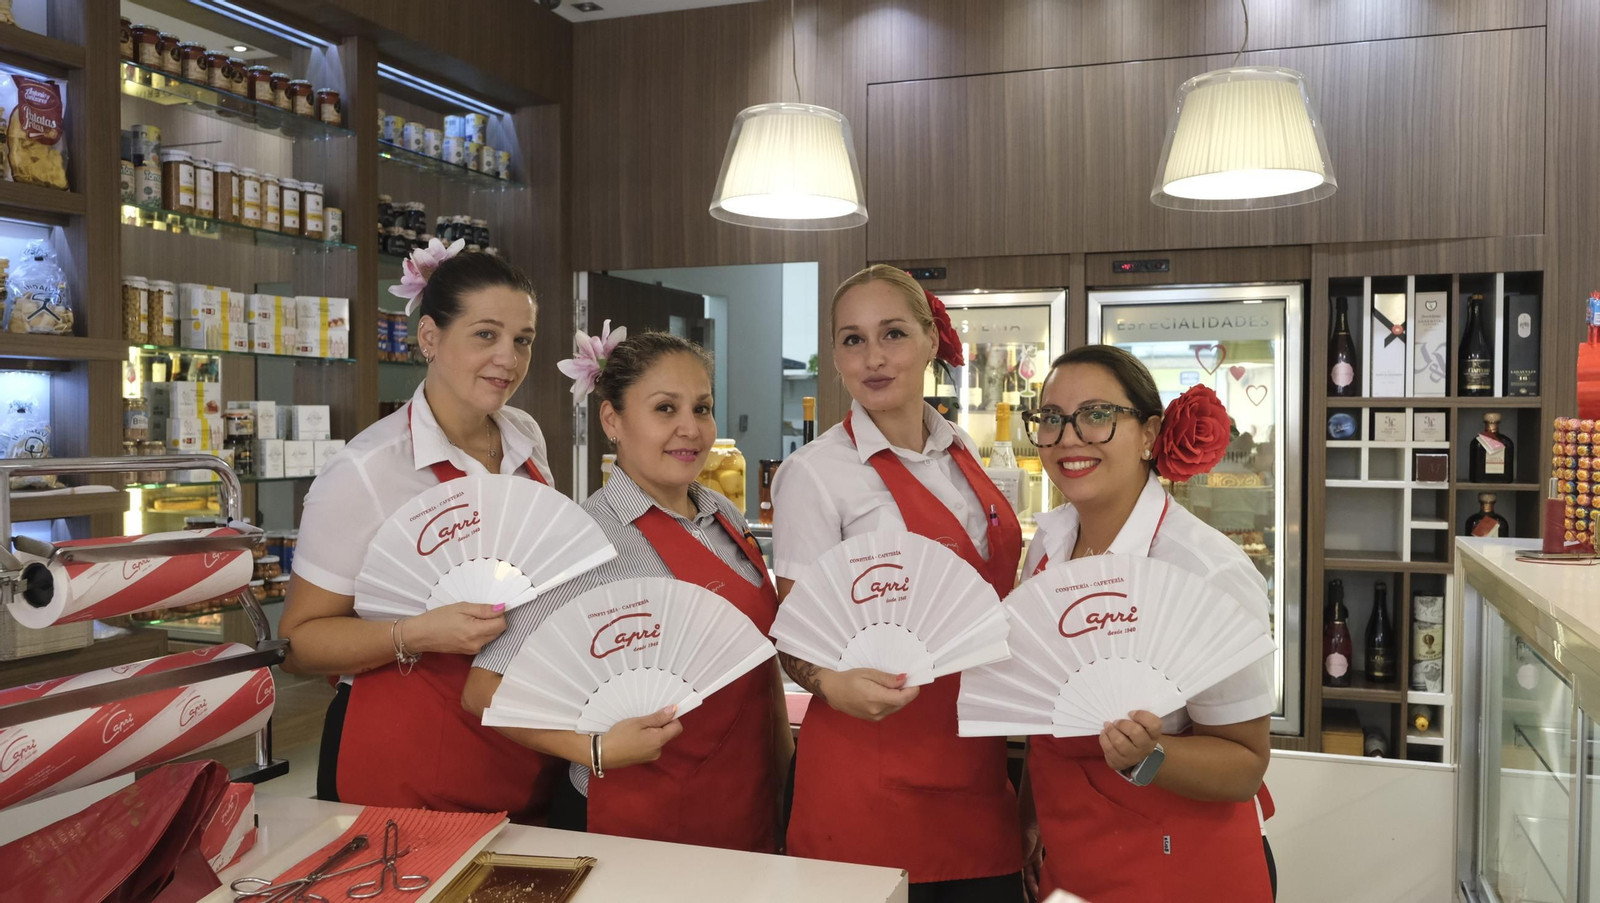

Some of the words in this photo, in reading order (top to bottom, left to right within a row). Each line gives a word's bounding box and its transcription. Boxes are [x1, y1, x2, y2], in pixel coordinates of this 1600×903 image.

[417, 503, 481, 556] Capri
[851, 562, 910, 605] Capri
[1055, 582, 1089, 593] CONFITERÍA
[1093, 577, 1125, 587] CAFETERÍA
[1058, 591, 1138, 638] Capri
[1107, 628, 1123, 636] desde
[590, 612, 661, 659] Capri
[102, 709, 134, 744] Capri
[179, 695, 208, 727] Capri
[1, 735, 37, 773] Capri
